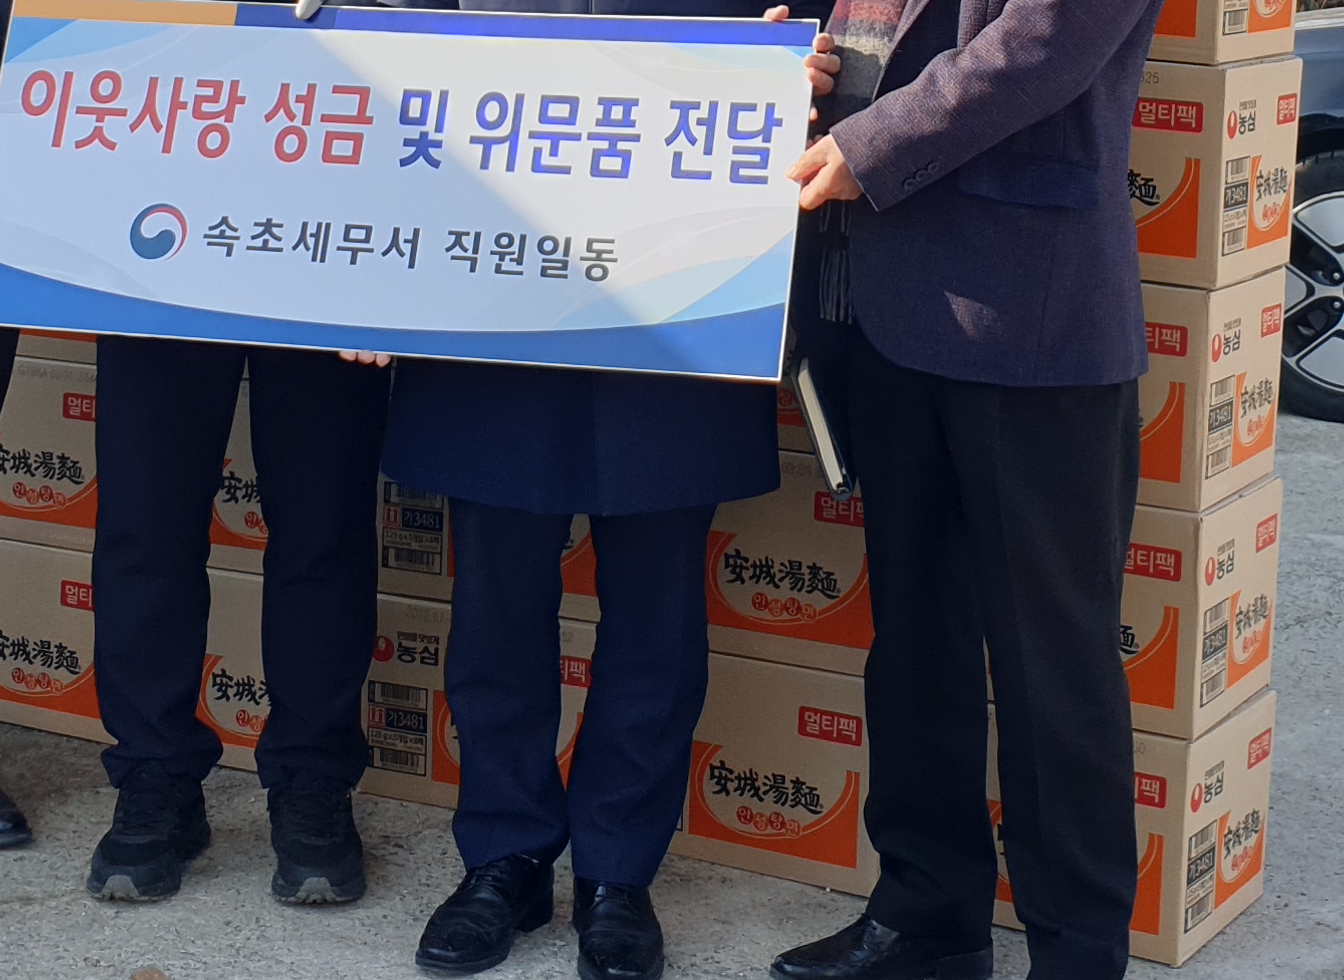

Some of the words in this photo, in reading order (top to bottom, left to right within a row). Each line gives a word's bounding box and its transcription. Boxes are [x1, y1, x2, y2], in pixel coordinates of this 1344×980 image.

[20, 68, 247, 159] 이웃사랑
[264, 81, 374, 166] 성금
[398, 89, 450, 170] 및
[469, 92, 641, 180] 위문품
[664, 98, 784, 185] 전달
[1138, 101, 1197, 128] 멀티팩
[1238, 110, 1256, 136] 농심
[202, 214, 421, 270] 속초세무서
[444, 228, 619, 283] 직원일동
[1145, 326, 1181, 353] 티팩
[1222, 328, 1241, 356] 농심
[68, 396, 96, 419] 멀티
[221, 471, 261, 504] 安城
[723, 548, 841, 600] 安城湯麵
[1216, 549, 1235, 581] 농심
[65, 585, 93, 608] 멀티
[396, 641, 439, 667] 농심
[804, 711, 857, 741] 멀티팩
[709, 760, 824, 816] 安城湯麵
[1204, 771, 1224, 804] 농심
